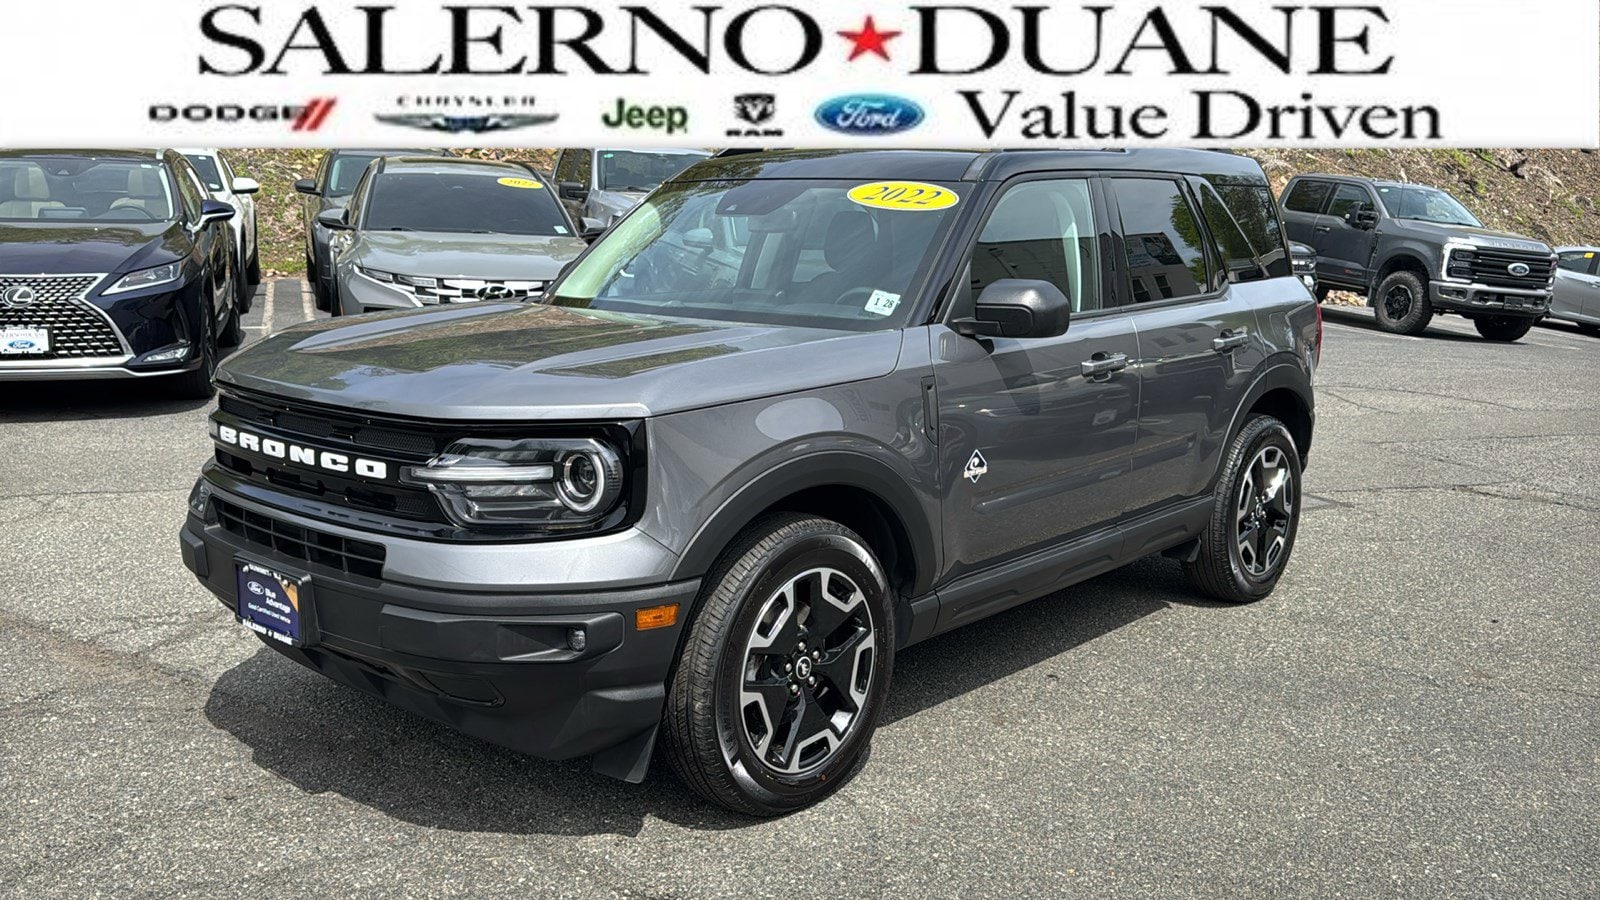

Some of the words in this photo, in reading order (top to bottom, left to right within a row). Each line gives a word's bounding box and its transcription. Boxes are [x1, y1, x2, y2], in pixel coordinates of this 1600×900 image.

[862, 186, 942, 205] 2022
[219, 425, 387, 479] BRONCO
[265, 588, 277, 599] Blue
